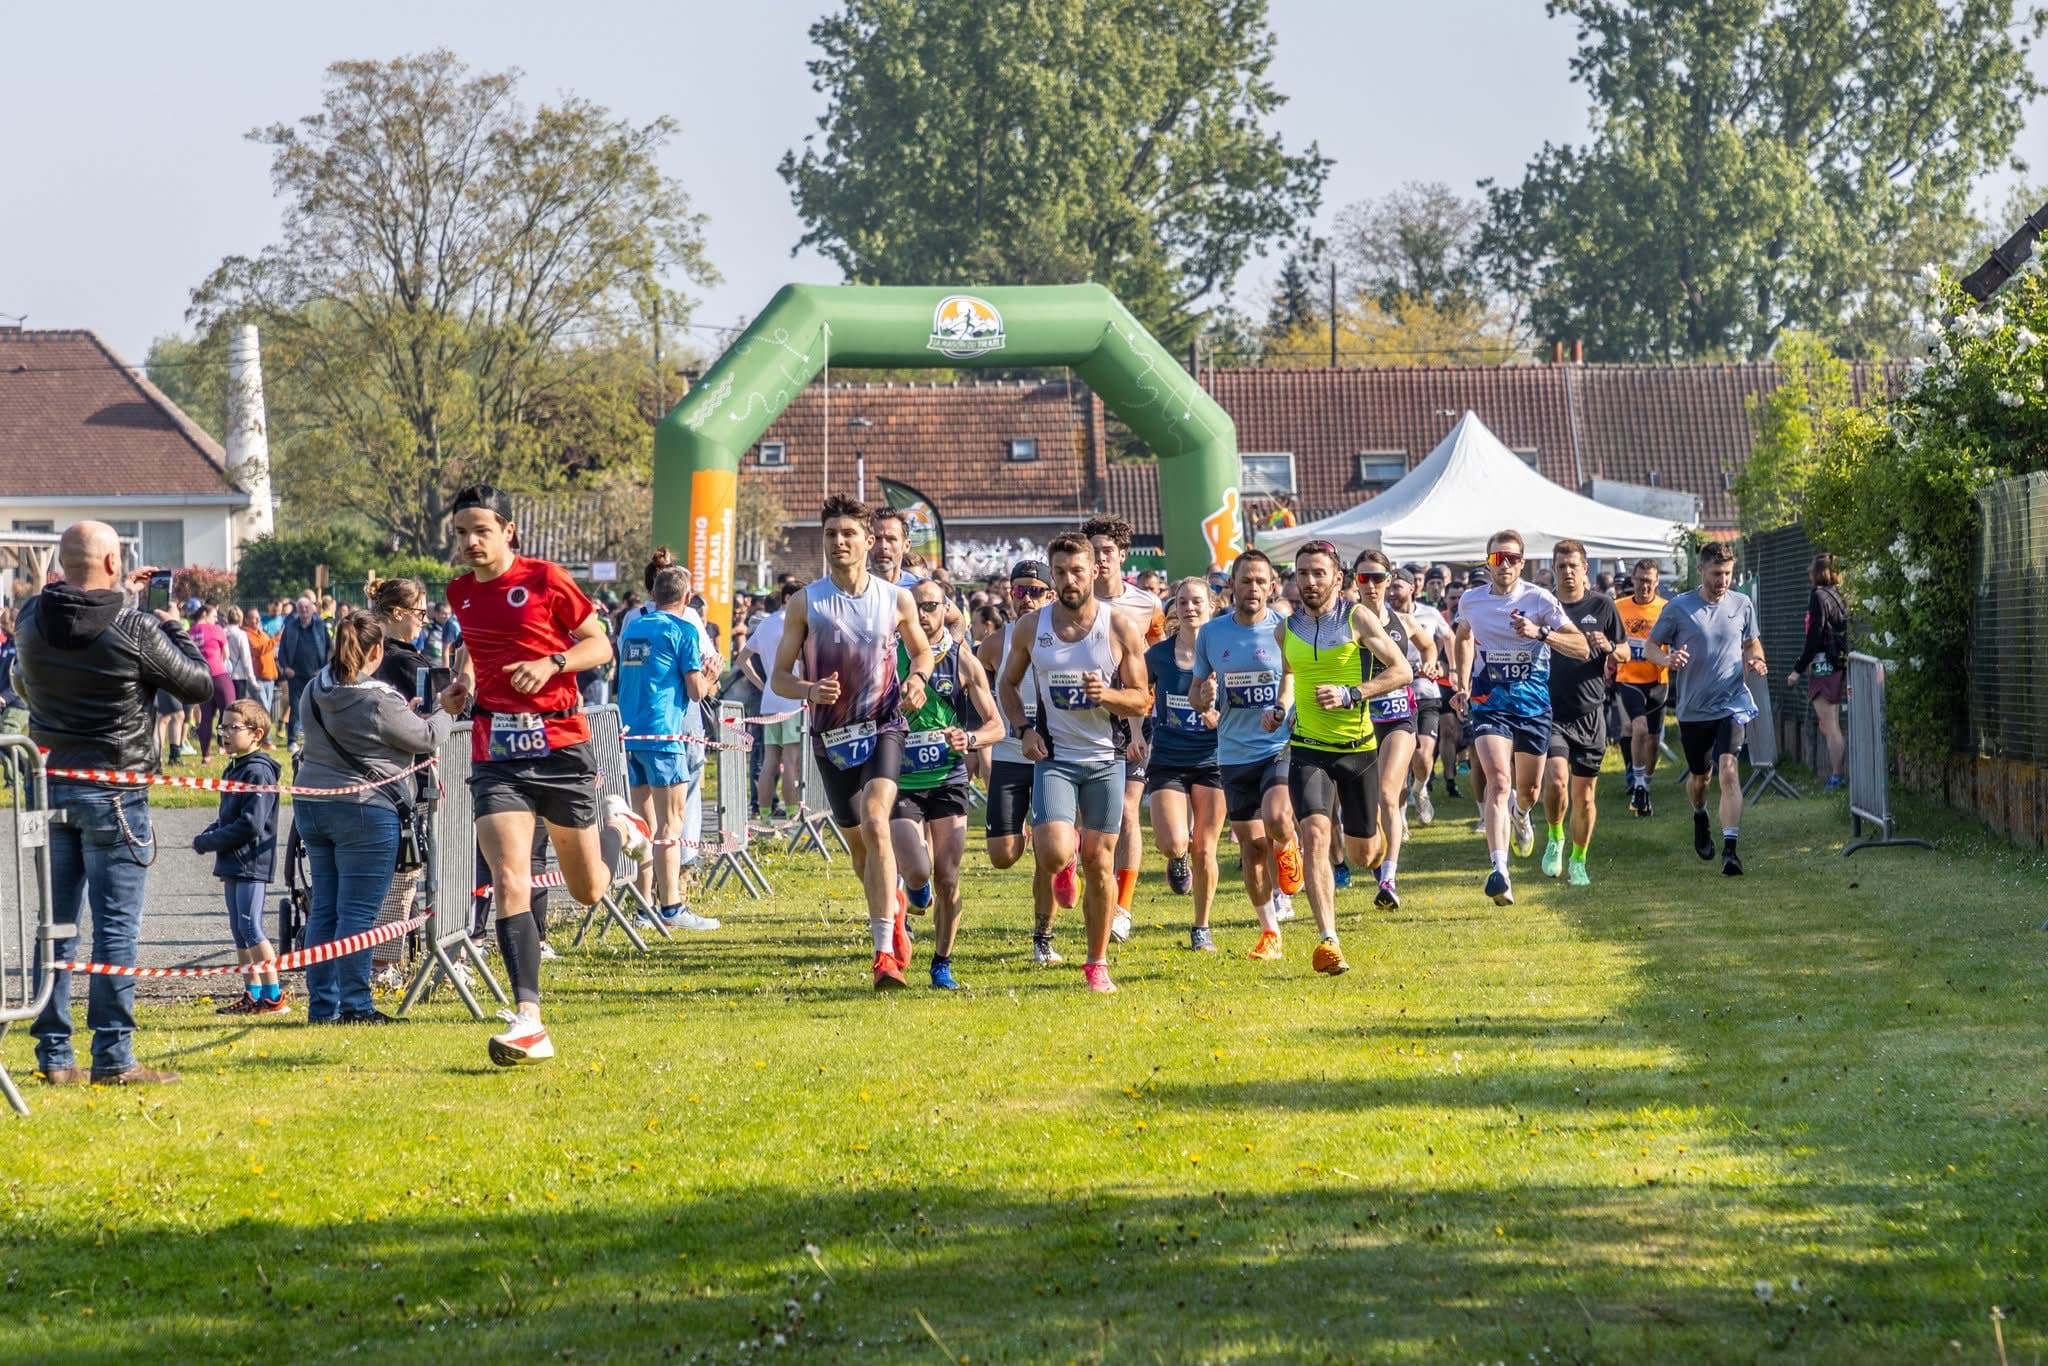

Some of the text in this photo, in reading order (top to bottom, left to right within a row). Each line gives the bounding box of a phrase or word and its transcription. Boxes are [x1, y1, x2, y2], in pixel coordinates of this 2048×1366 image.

[693, 516, 708, 593] RUNNING
[709, 532, 721, 577] TRAIL
[1502, 664, 1530, 679] 192
[1068, 688, 1087, 704] 27
[1243, 686, 1274, 703] 189
[1381, 698, 1408, 715] 259
[506, 731, 546, 752] 108
[848, 739, 869, 760] 71
[918, 745, 940, 764] 69
